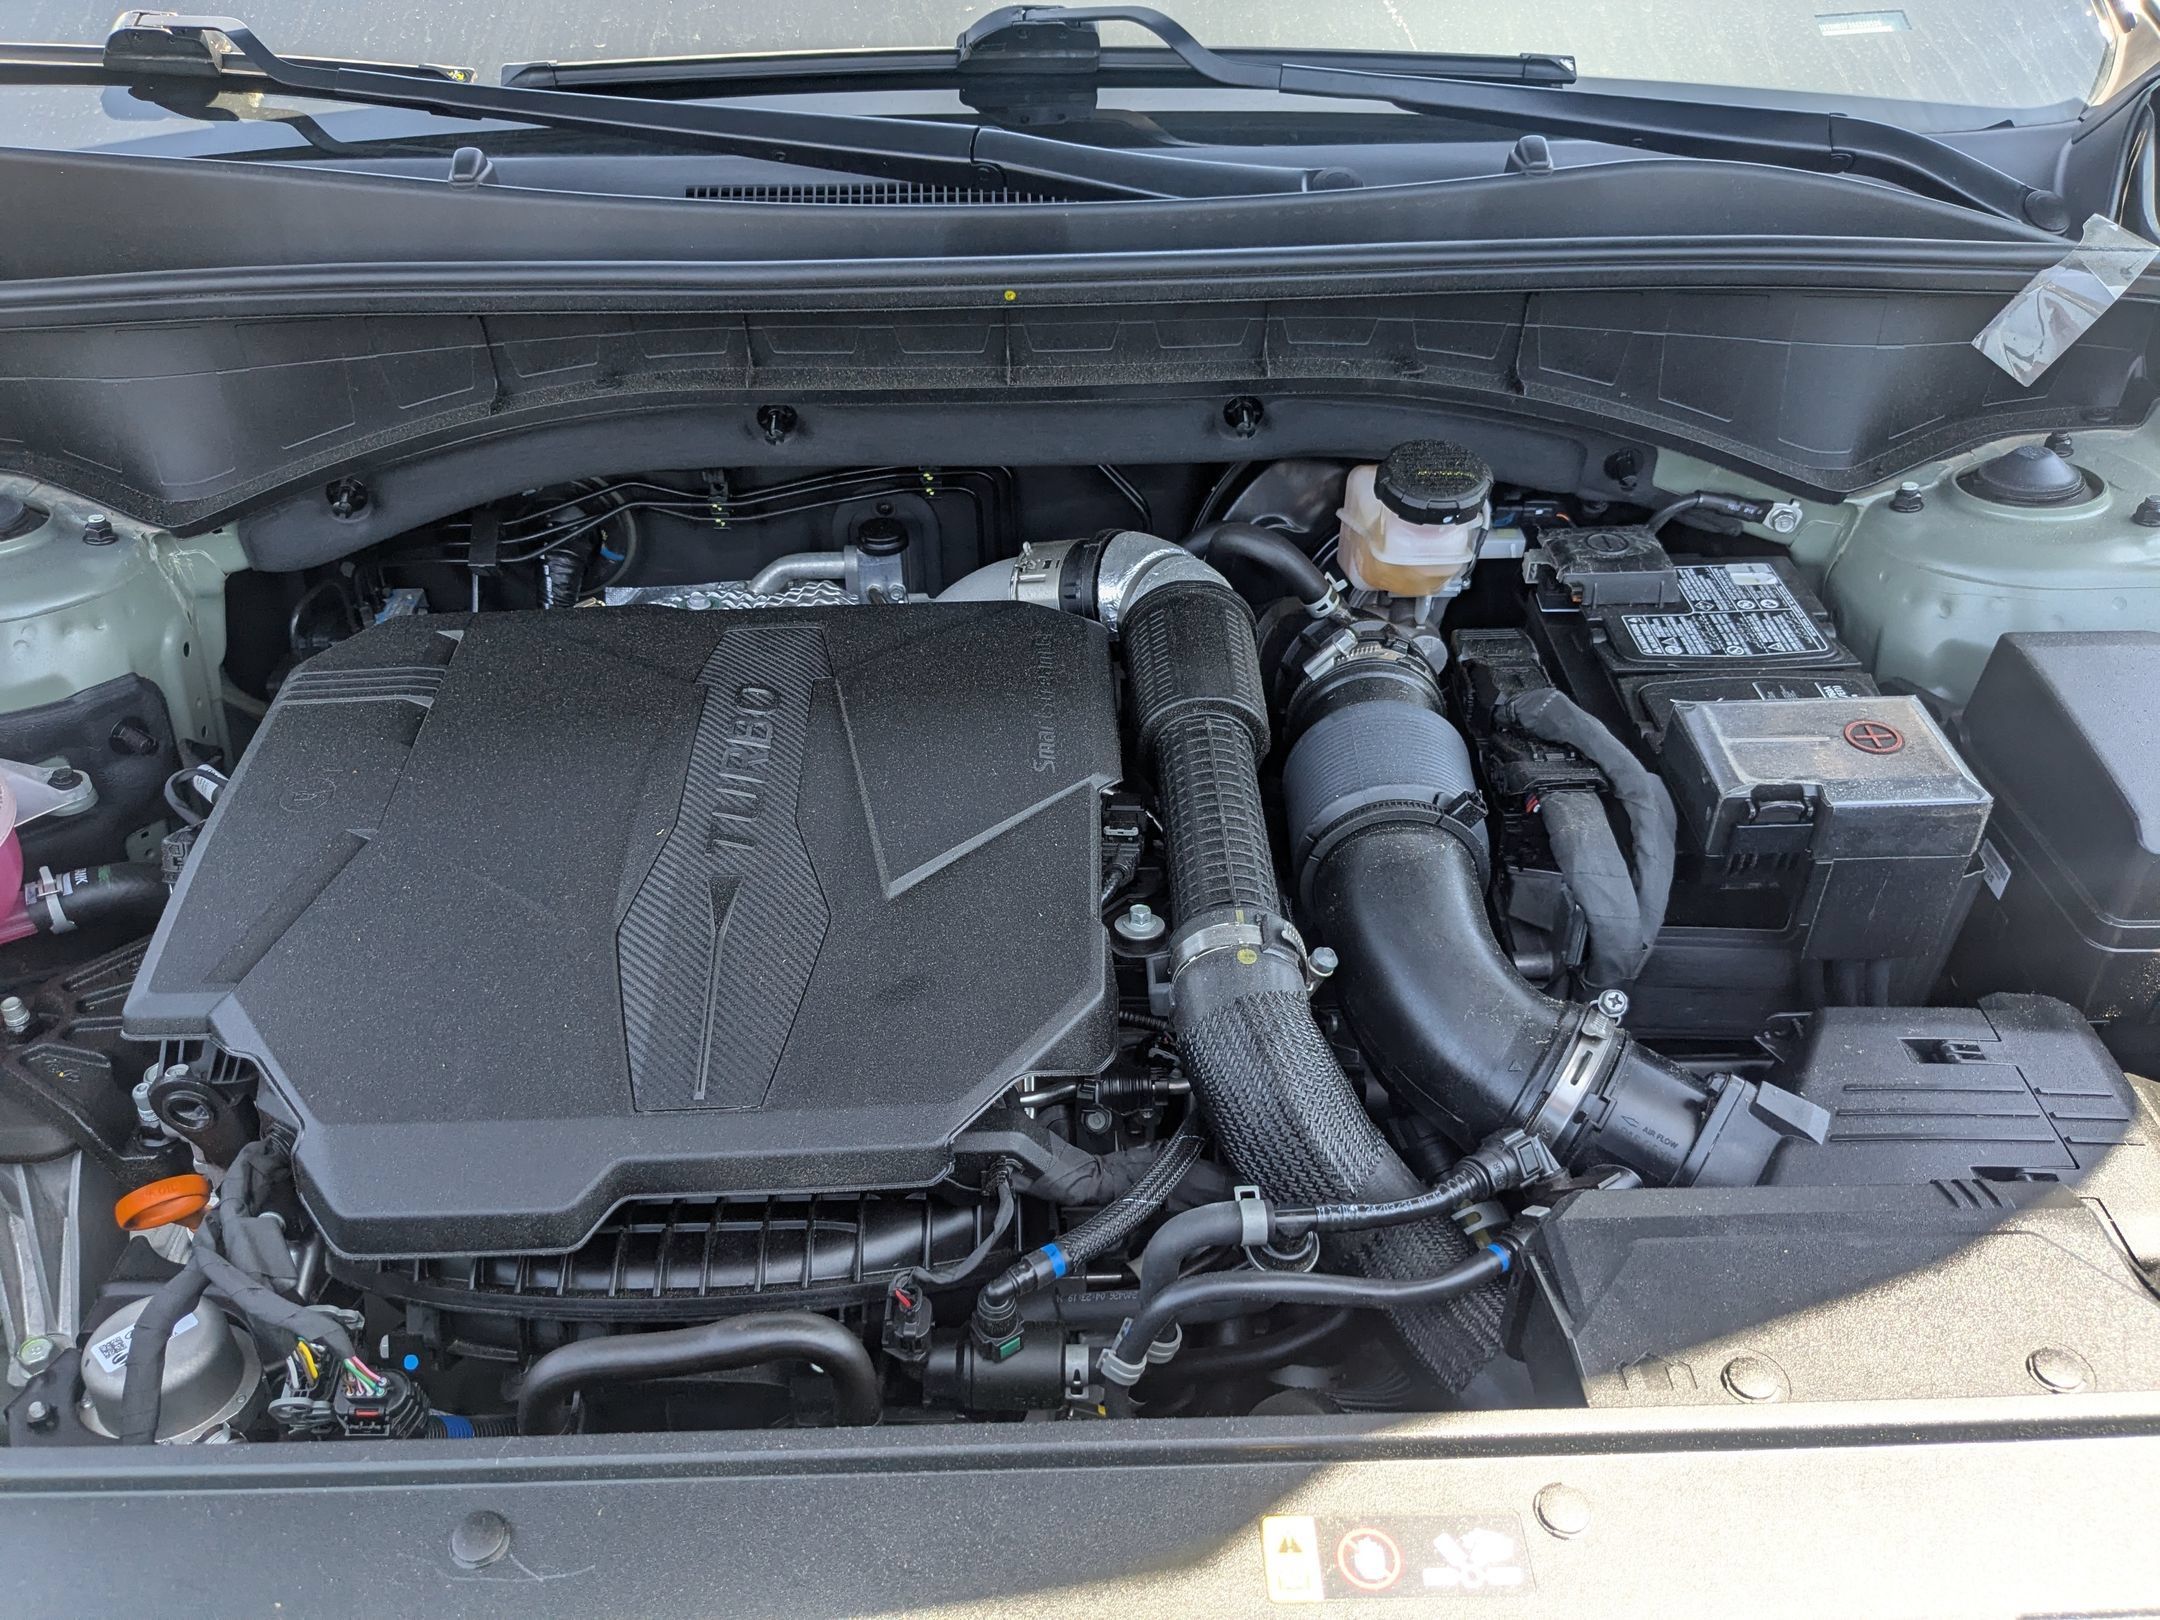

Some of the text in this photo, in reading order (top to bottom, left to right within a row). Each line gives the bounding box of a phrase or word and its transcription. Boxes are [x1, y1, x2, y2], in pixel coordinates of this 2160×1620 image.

[704, 684, 778, 856] TURBO
[1642, 1126, 1679, 1149] AIR FLOW
[159, 1184, 178, 1195] OIL
